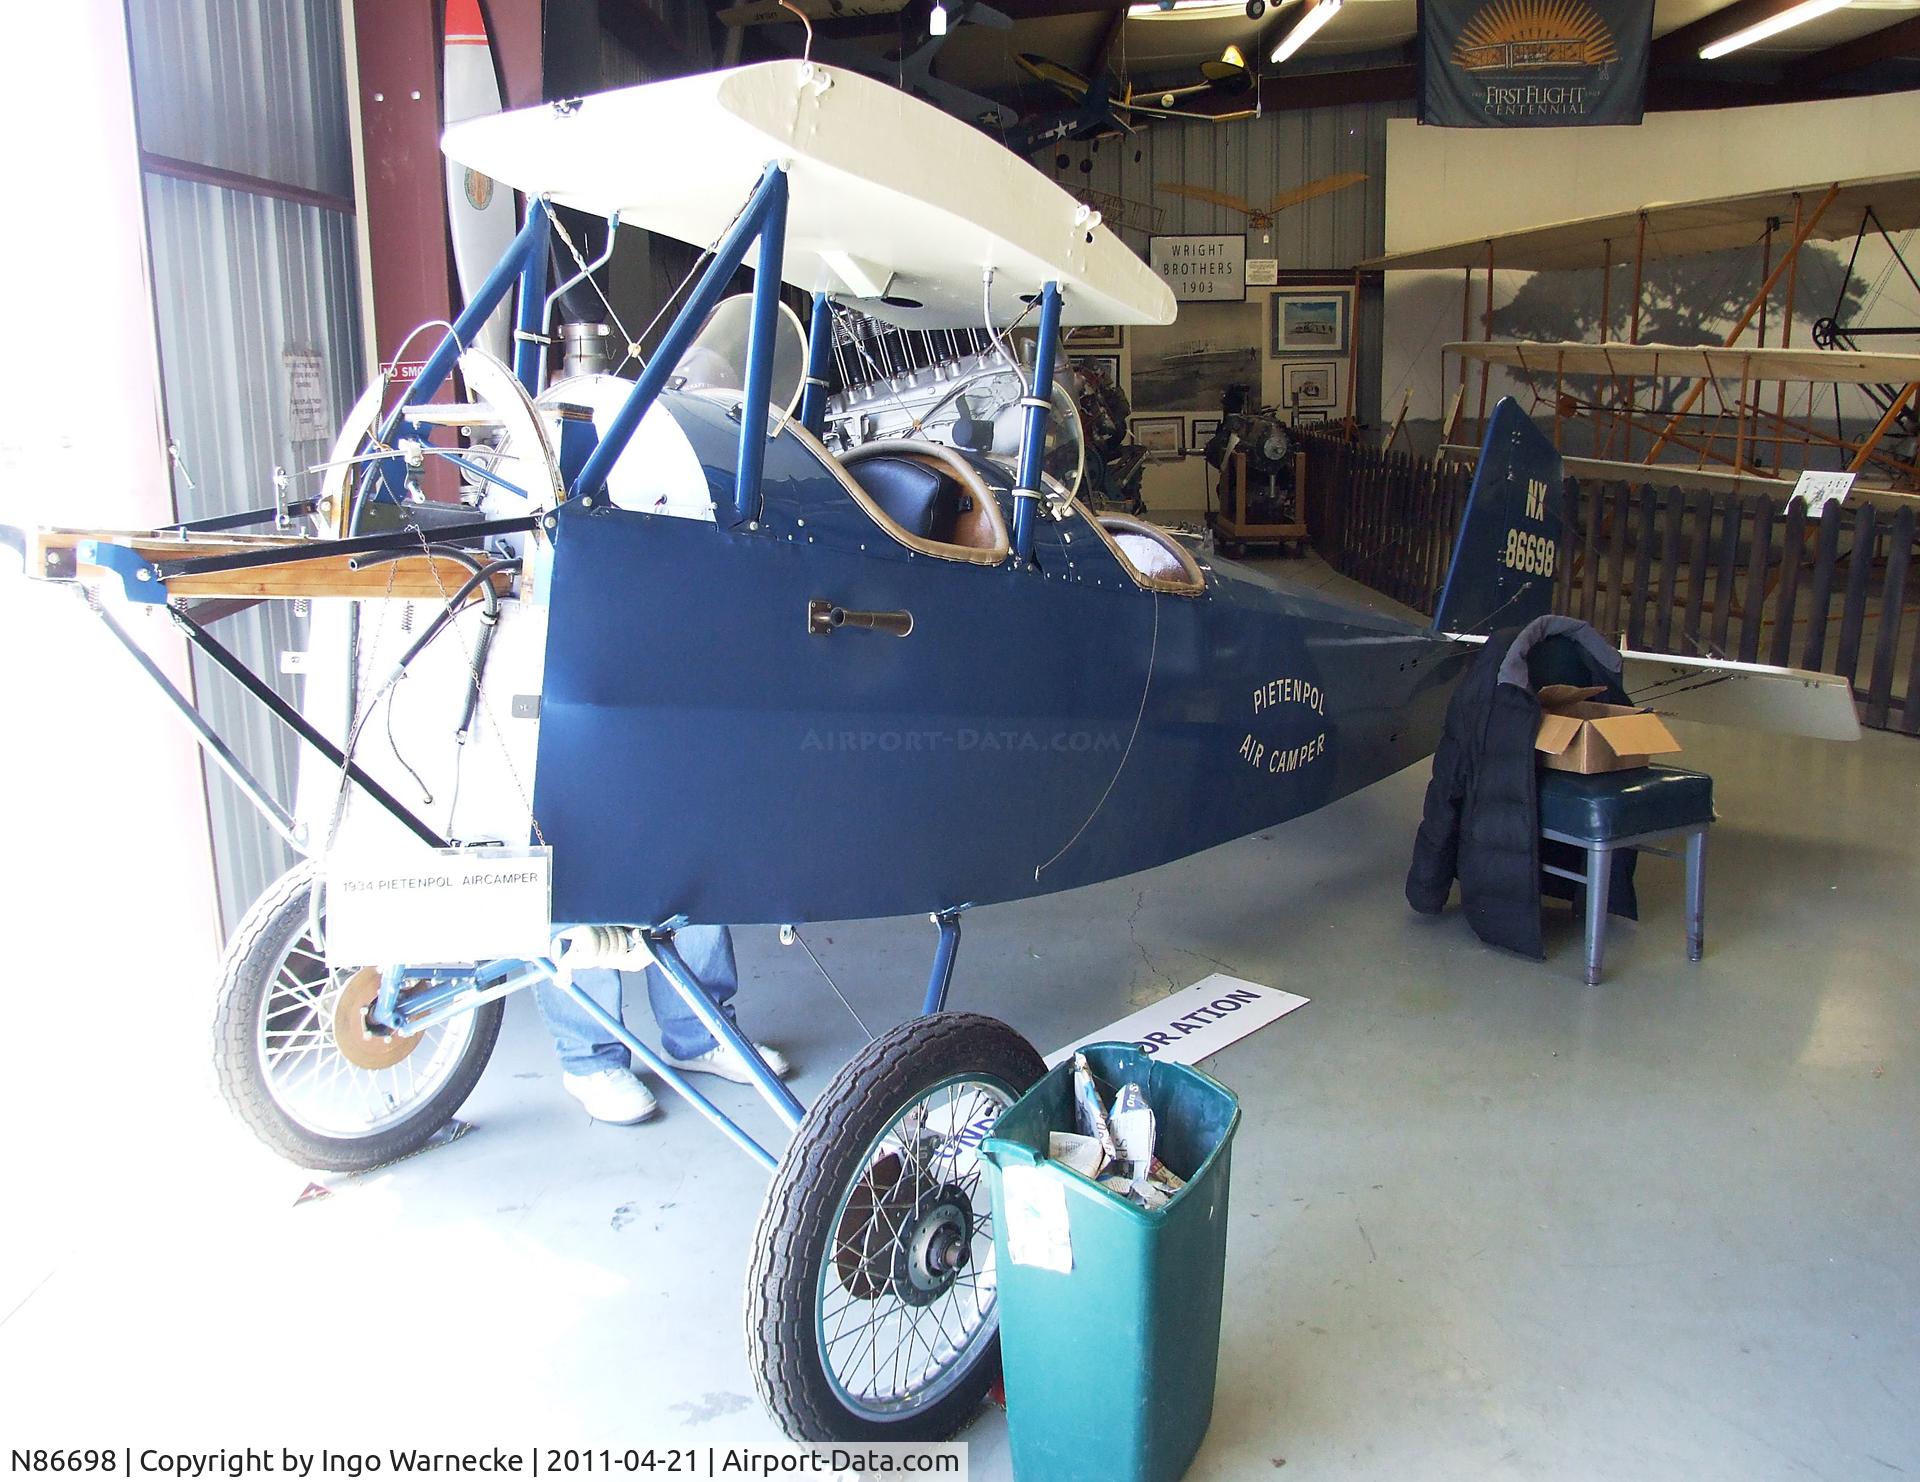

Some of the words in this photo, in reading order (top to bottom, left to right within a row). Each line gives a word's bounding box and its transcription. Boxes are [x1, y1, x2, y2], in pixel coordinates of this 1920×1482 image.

[1486, 86, 1525, 104] FIRST
[1526, 85, 1586, 104] FLIGHT
[1484, 103, 1586, 116] CENTENNIAL
[1172, 244, 1225, 256] WRIGHT
[1163, 262, 1233, 275] BROTHERS
[1183, 281, 1214, 294] 1903
[1525, 478, 1548, 521] NX
[1505, 528, 1555, 577] 86698
[1253, 678, 1324, 716] PIETENPOL
[1240, 734, 1264, 768] AIR
[1269, 733, 1325, 773] CAMPER
[344, 881, 373, 892] 1934
[378, 876, 453, 890] PIETENPOL
[463, 872, 538, 886] AIRCAMPER
[1133, 989, 1262, 1055] ORATION
